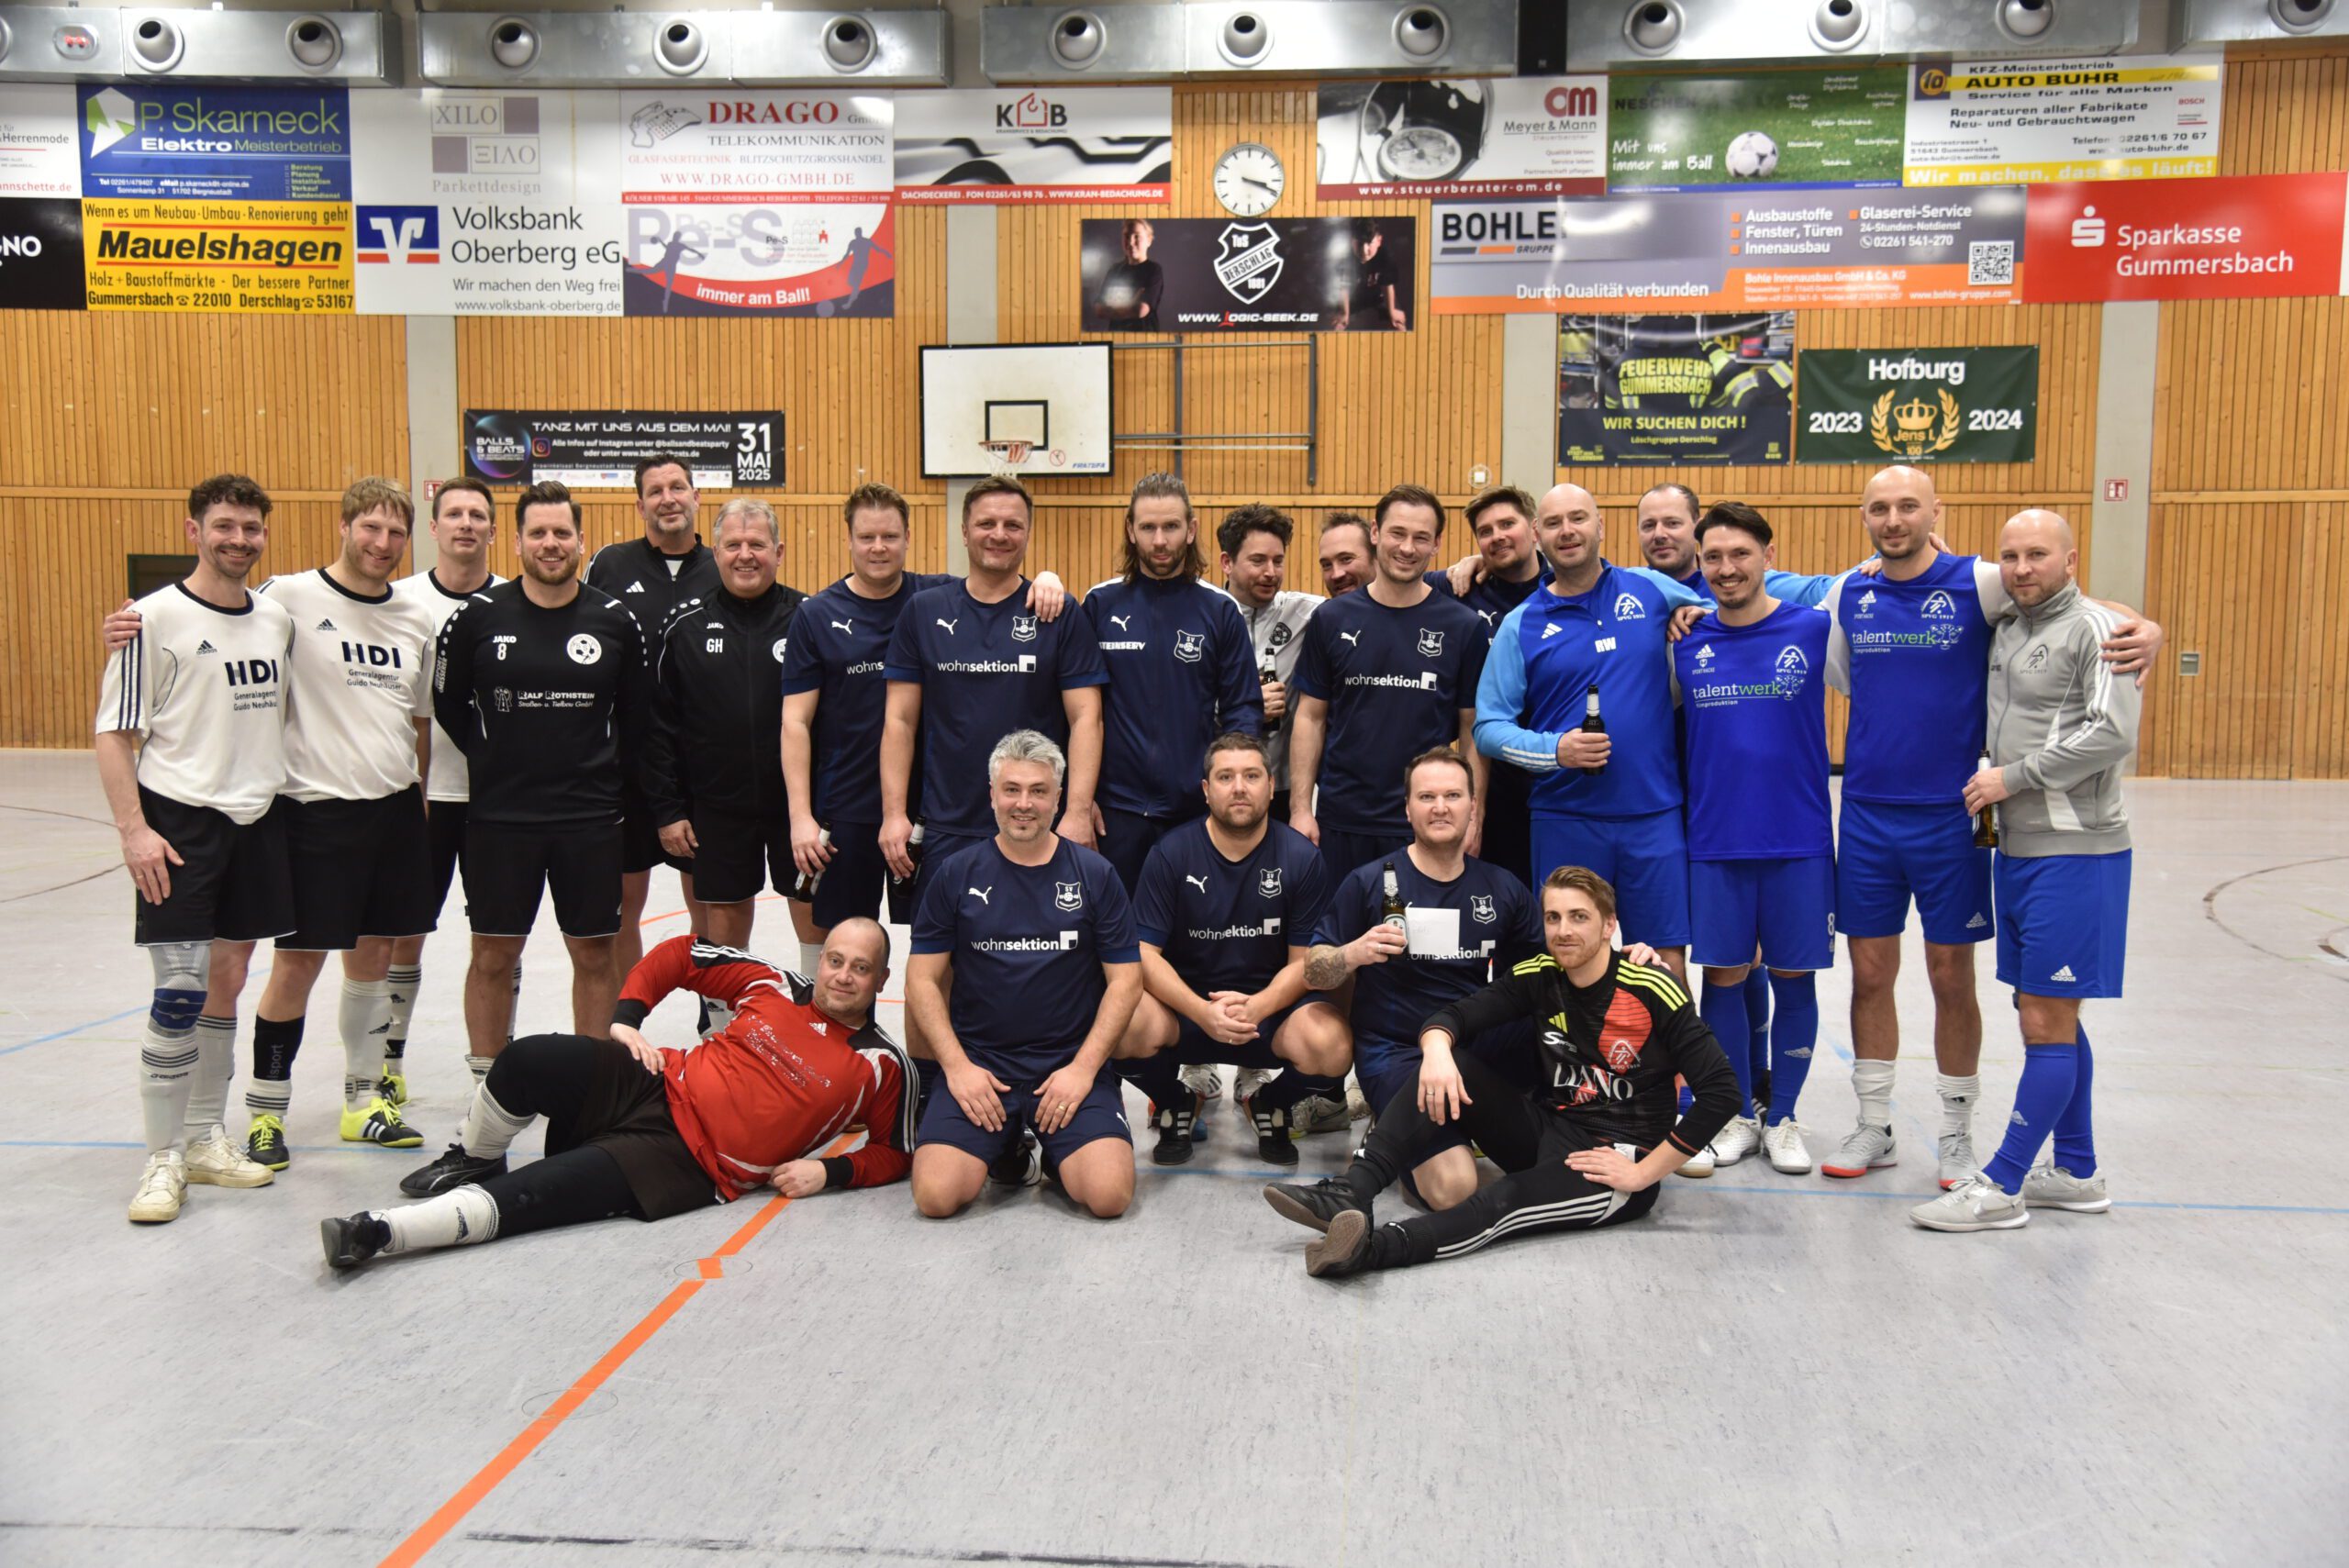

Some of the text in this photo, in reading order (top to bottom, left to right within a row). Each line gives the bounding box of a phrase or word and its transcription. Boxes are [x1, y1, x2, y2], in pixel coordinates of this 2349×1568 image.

[1969, 61, 2114, 74] KFZ-Meisterbetrieb
[1965, 72, 2120, 88] AUTO BUHR
[1968, 84, 2173, 100] Service für alle Marken
[141, 96, 341, 134] P. Skarneck
[435, 105, 497, 125] XILO
[707, 101, 840, 125] DRAGO
[1951, 100, 2148, 118] Reparaturen aller Fabrikate
[1504, 119, 1597, 135] Meyer & Mann
[1950, 114, 2135, 129] Neu- und Gebrauchtwagen
[707, 135, 885, 147] TELEKOMMUNIKATION
[2173, 131, 2208, 142] 70 67
[141, 138, 342, 153] Elektro Meisterbetrieb
[1612, 139, 1667, 154] Mit uns
[628, 154, 731, 164] GLASFASERTECHNIK
[1612, 154, 1713, 172] immer am Ball
[661, 173, 855, 185] WWW.DRAGO-GMBH.DE
[1909, 168, 1954, 184] Wir
[1959, 166, 2050, 183] machen,
[2153, 160, 2213, 178] läuft!
[432, 180, 541, 196] Parkettdesign
[901, 189, 1163, 199] DACHDECKEREI FON WWW.KRAN-BEDACHUNG.DE
[84, 204, 117, 219] Wenn
[117, 207, 129, 218] es
[133, 207, 150, 219] um
[248, 206, 317, 225] Renovierung
[323, 208, 348, 222] geht
[452, 206, 584, 230] Volksbank
[1745, 207, 1833, 223] Ausbaustoffe
[1859, 205, 1972, 220] Glaserei-Service
[1442, 211, 1557, 241] BOHLE
[1745, 223, 1843, 240] Fenster, Türen
[1860, 220, 1962, 232] 24-Stunden-Notdienst
[1874, 234, 1954, 248] 02261 541-270
[2117, 222, 2242, 250] Sparkasse
[97, 230, 342, 267] Mauelshagen
[451, 239, 621, 271] Oberberg eG
[1517, 245, 1554, 254] GRUPPE
[1745, 240, 1831, 255] Innenausbau
[1223, 247, 1273, 282] DERSCHLAG
[2117, 250, 2293, 276] Gummersbach
[90, 272, 351, 290] Holz Baustoffmärkte Der bessere Partner
[1745, 270, 1906, 283] Bohle Innenausbau GmbH KG
[452, 279, 621, 295] Wir machen den Weg frei
[696, 284, 811, 305] immer am Ball!
[1517, 284, 1709, 299] Durch Qualität verbunden
[88, 292, 353, 310] Gummersbach 22010 Derschlag 53167
[455, 299, 622, 313] www.volksbank-oberberg.de
[1619, 358, 1713, 378] FEUERWEHR
[1868, 358, 1965, 384] Hofburg
[1619, 375, 1713, 395] GUMMERSBACH
[1603, 416, 1738, 430] WIR SUCHEN DICH
[1809, 412, 1863, 433] 2023
[1968, 409, 2023, 430] 2024
[532, 423, 731, 434] TANZ MIT UNS AUS DEM MAI!
[1893, 428, 1926, 441] Jens
[476, 437, 514, 446] BALLS
[552, 439, 566, 448] Alle
[567, 439, 585, 448] Infos
[586, 439, 598, 448] auf
[599, 439, 633, 450] Instagram
[738, 423, 771, 452] 31
[1631, 435, 1717, 445] Löschgruppe Derschlag
[487, 445, 526, 454] BEATS
[601, 450, 620, 458] unter
[1907, 446, 1923, 456] 100
[738, 452, 772, 469] MAI
[738, 469, 771, 481] 2025
[493, 635, 517, 644] JAKO
[1595, 637, 1616, 653] RW
[1852, 628, 1936, 646] talentwerk
[497, 643, 507, 661] 8
[707, 639, 723, 653] GH
[341, 641, 402, 669] HDI
[938, 655, 1019, 673] wohnsektion
[225, 659, 278, 686] HDI
[349, 669, 400, 681] Generalagentur
[347, 678, 368, 687] Guido
[1344, 673, 1420, 690] wohnsektion
[518, 690, 596, 700] RALF ROTHSTEIN
[1693, 680, 1783, 700] talentwerk
[234, 702, 251, 711] Guido
[1827, 912, 1835, 936] 8
[1965, 920, 1987, 929] adidas
[1188, 925, 1264, 940] wohnsektion
[971, 938, 1059, 952] wohnsektion
